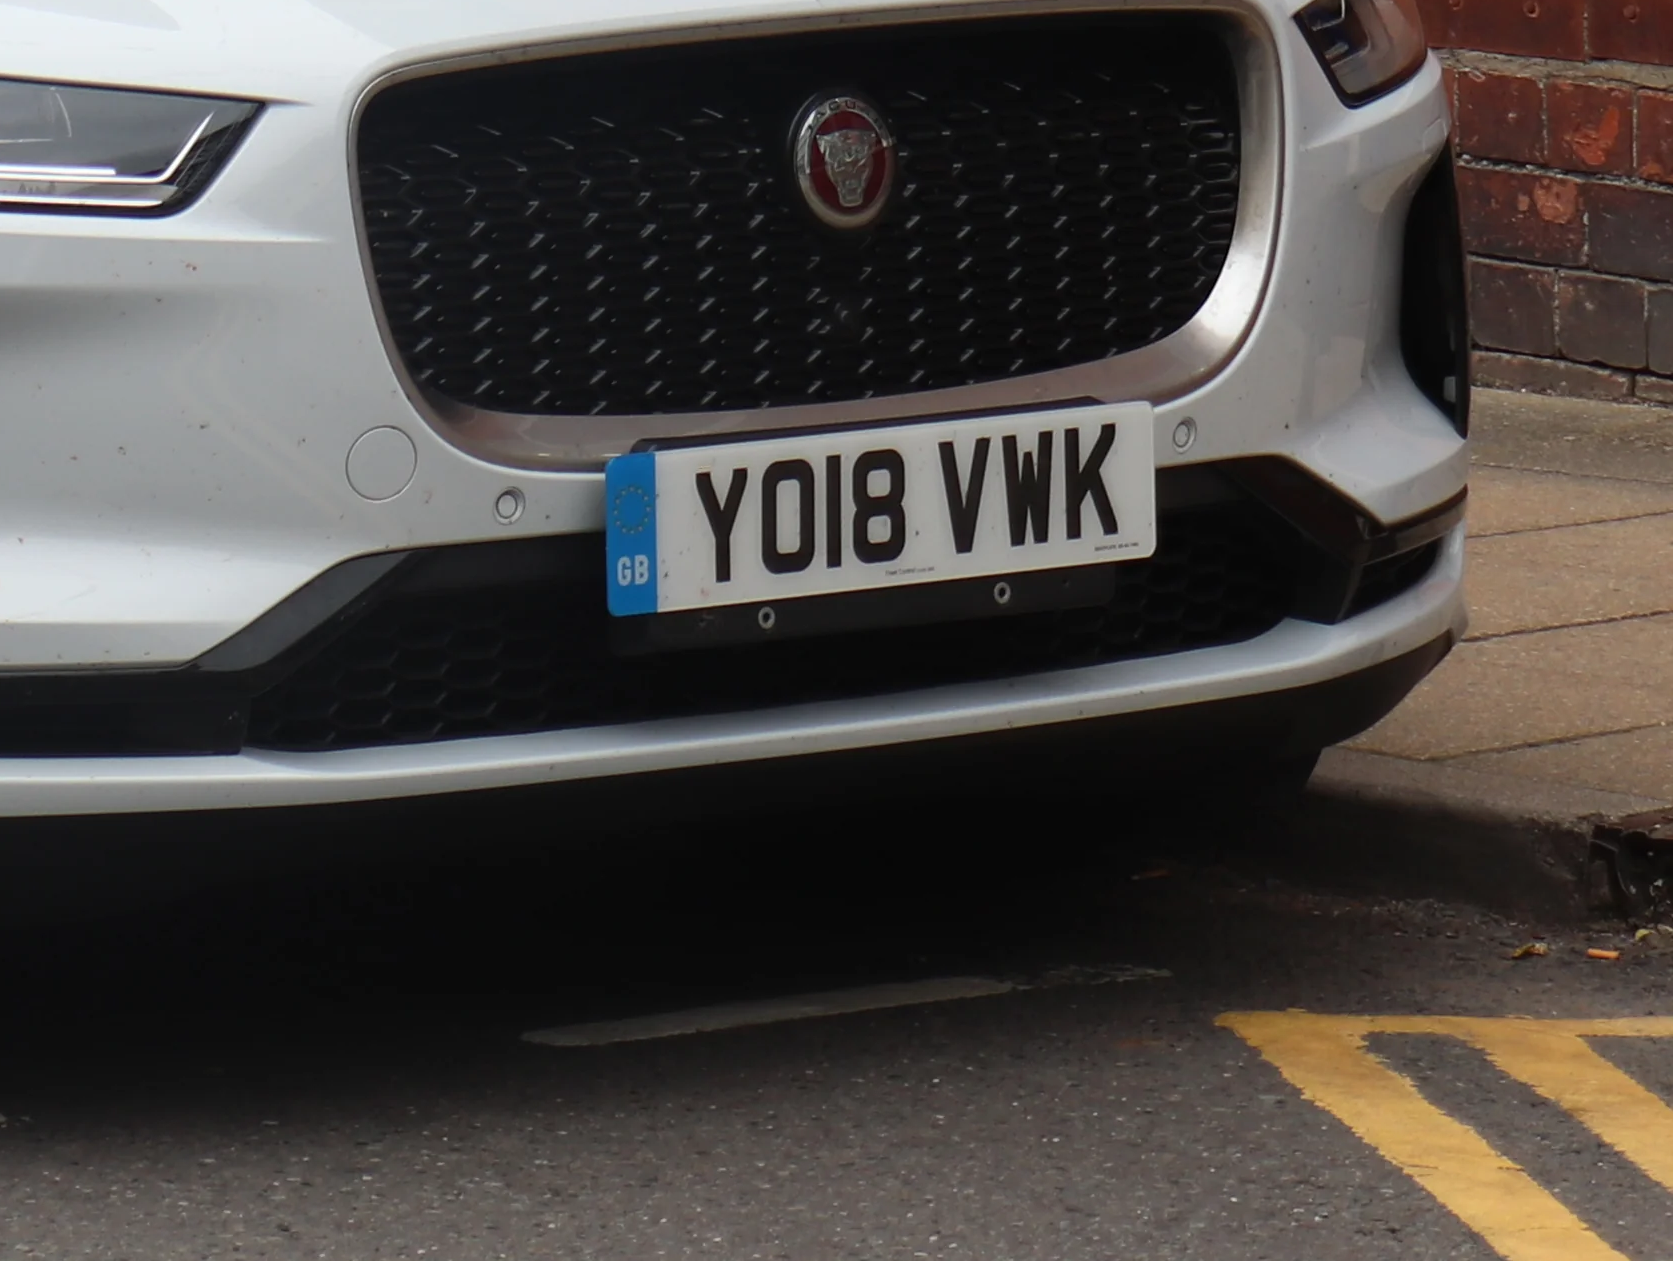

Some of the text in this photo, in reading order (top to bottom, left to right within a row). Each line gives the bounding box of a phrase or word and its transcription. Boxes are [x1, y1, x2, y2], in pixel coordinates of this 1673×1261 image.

[695, 423, 1119, 584] YO18 VWK
[616, 554, 649, 587] GB
